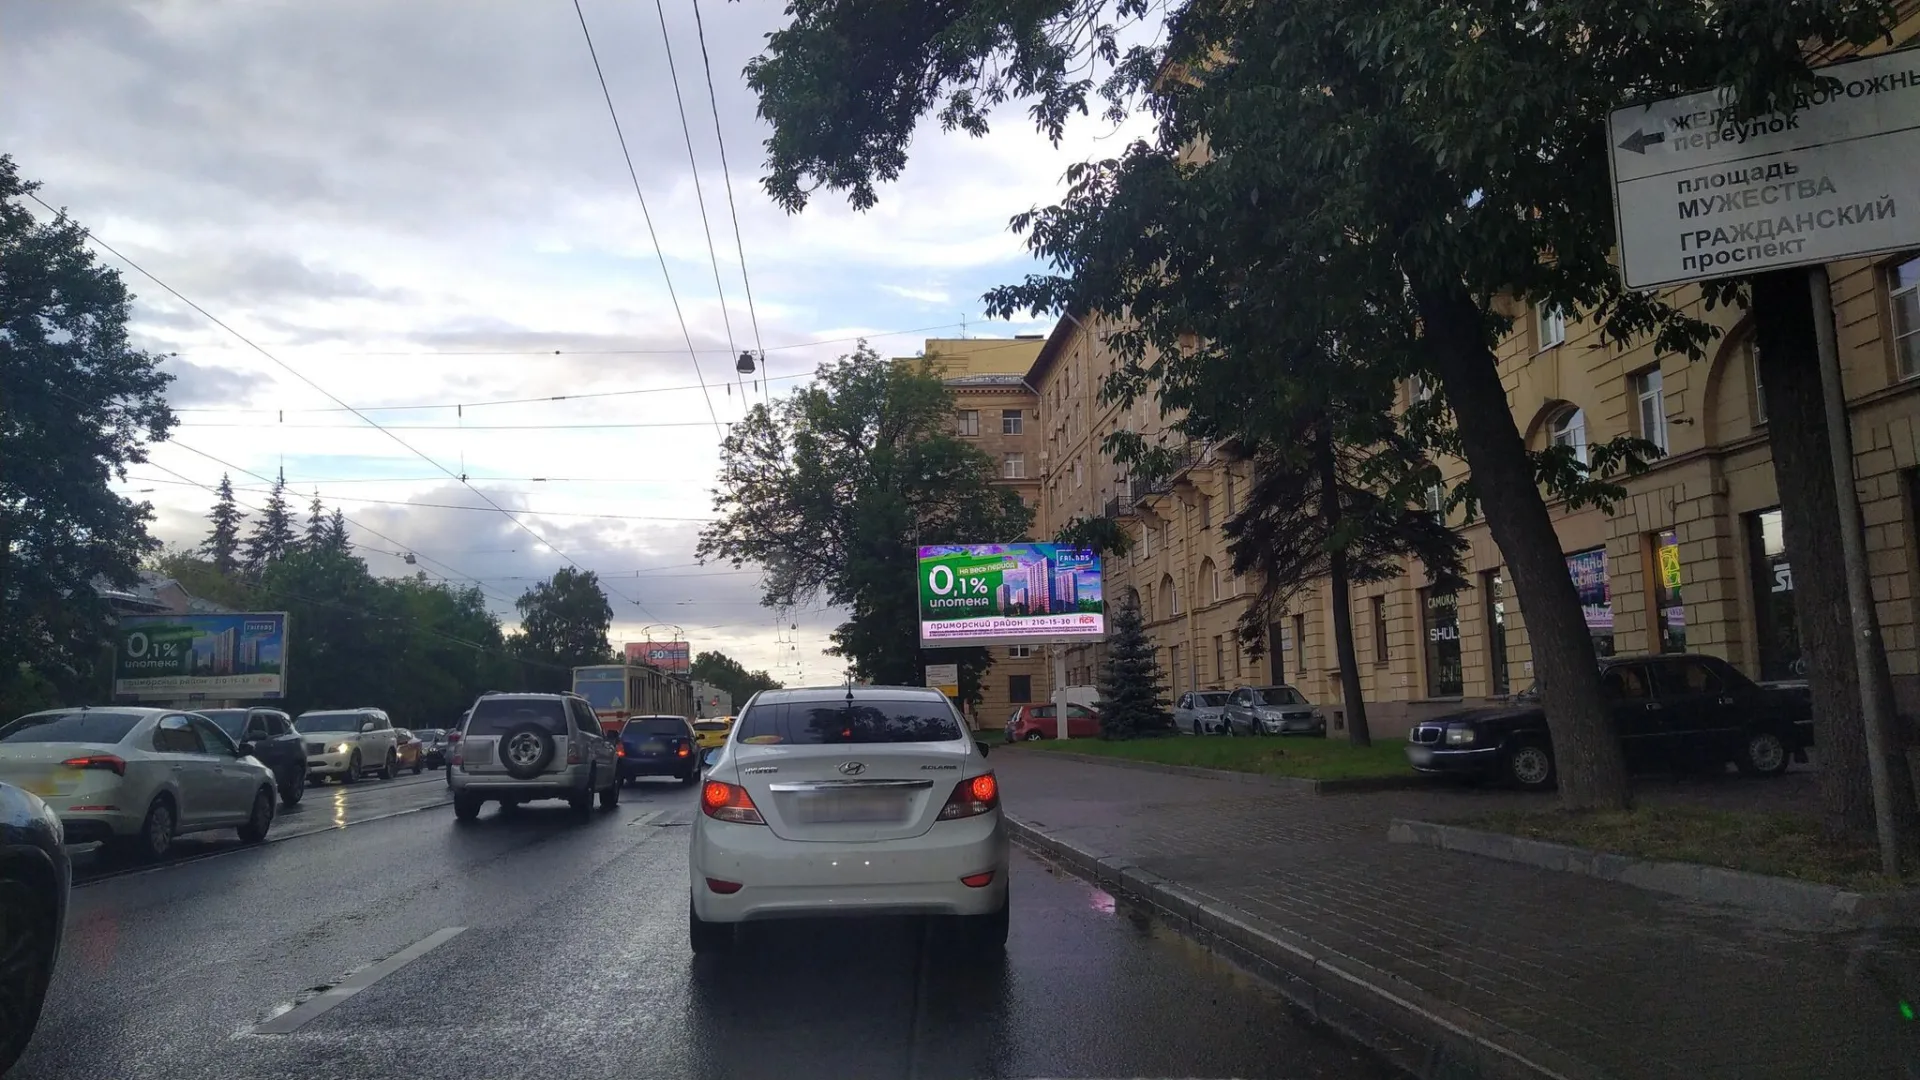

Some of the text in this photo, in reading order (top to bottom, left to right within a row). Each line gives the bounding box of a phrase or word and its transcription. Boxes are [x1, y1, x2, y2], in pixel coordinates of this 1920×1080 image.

[1674, 113, 1800, 152] переулок
[1677, 160, 1799, 195] площадь
[1678, 175, 1837, 219] МУЖЕСТВА
[1679, 194, 1897, 251] ГРАЖДАНСКИЙ
[1682, 236, 1807, 272] проспект
[1059, 554, 1090, 562] FRINDS
[929, 565, 988, 597] 0,1%
[929, 597, 989, 608] ипотека
[930, 618, 1023, 630] приморский район
[1031, 618, 1071, 626] 210-15-30
[1429, 626, 1460, 642] SHUL
[127, 632, 178, 659] 0,1%
[125, 660, 179, 669] ипотека
